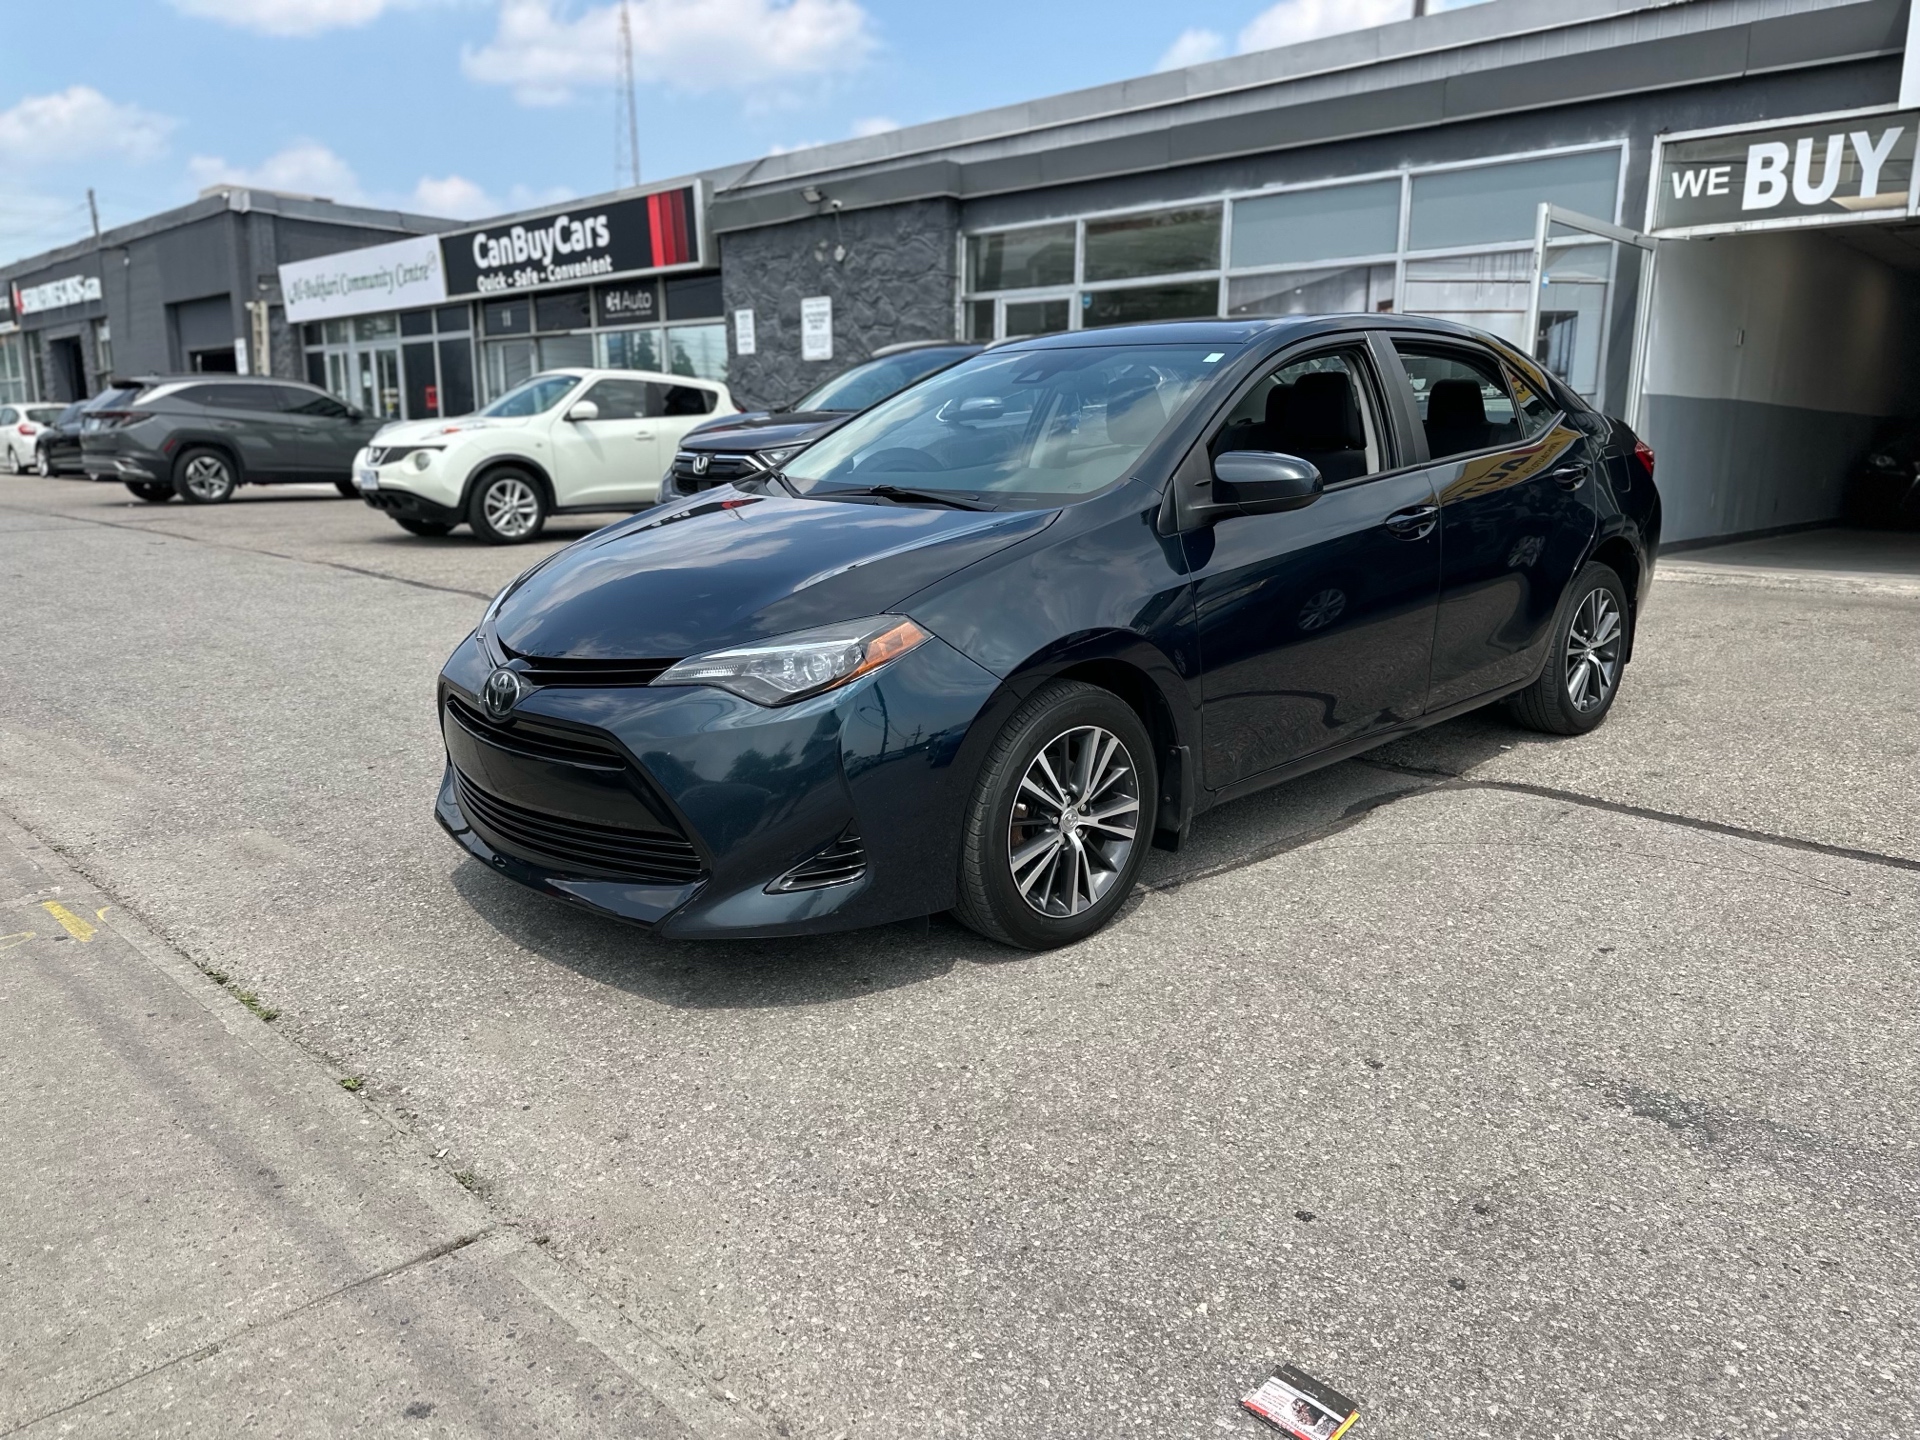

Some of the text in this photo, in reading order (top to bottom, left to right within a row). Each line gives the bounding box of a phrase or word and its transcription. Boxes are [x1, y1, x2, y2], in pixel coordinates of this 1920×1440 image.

[1672, 127, 1905, 210] WE BUY
[473, 215, 610, 269] CanBuyCars
[340, 265, 394, 296] Community
[395, 262, 430, 288] Centre
[477, 254, 613, 293] Quick Safe Convenient
[622, 290, 652, 309] Auto
